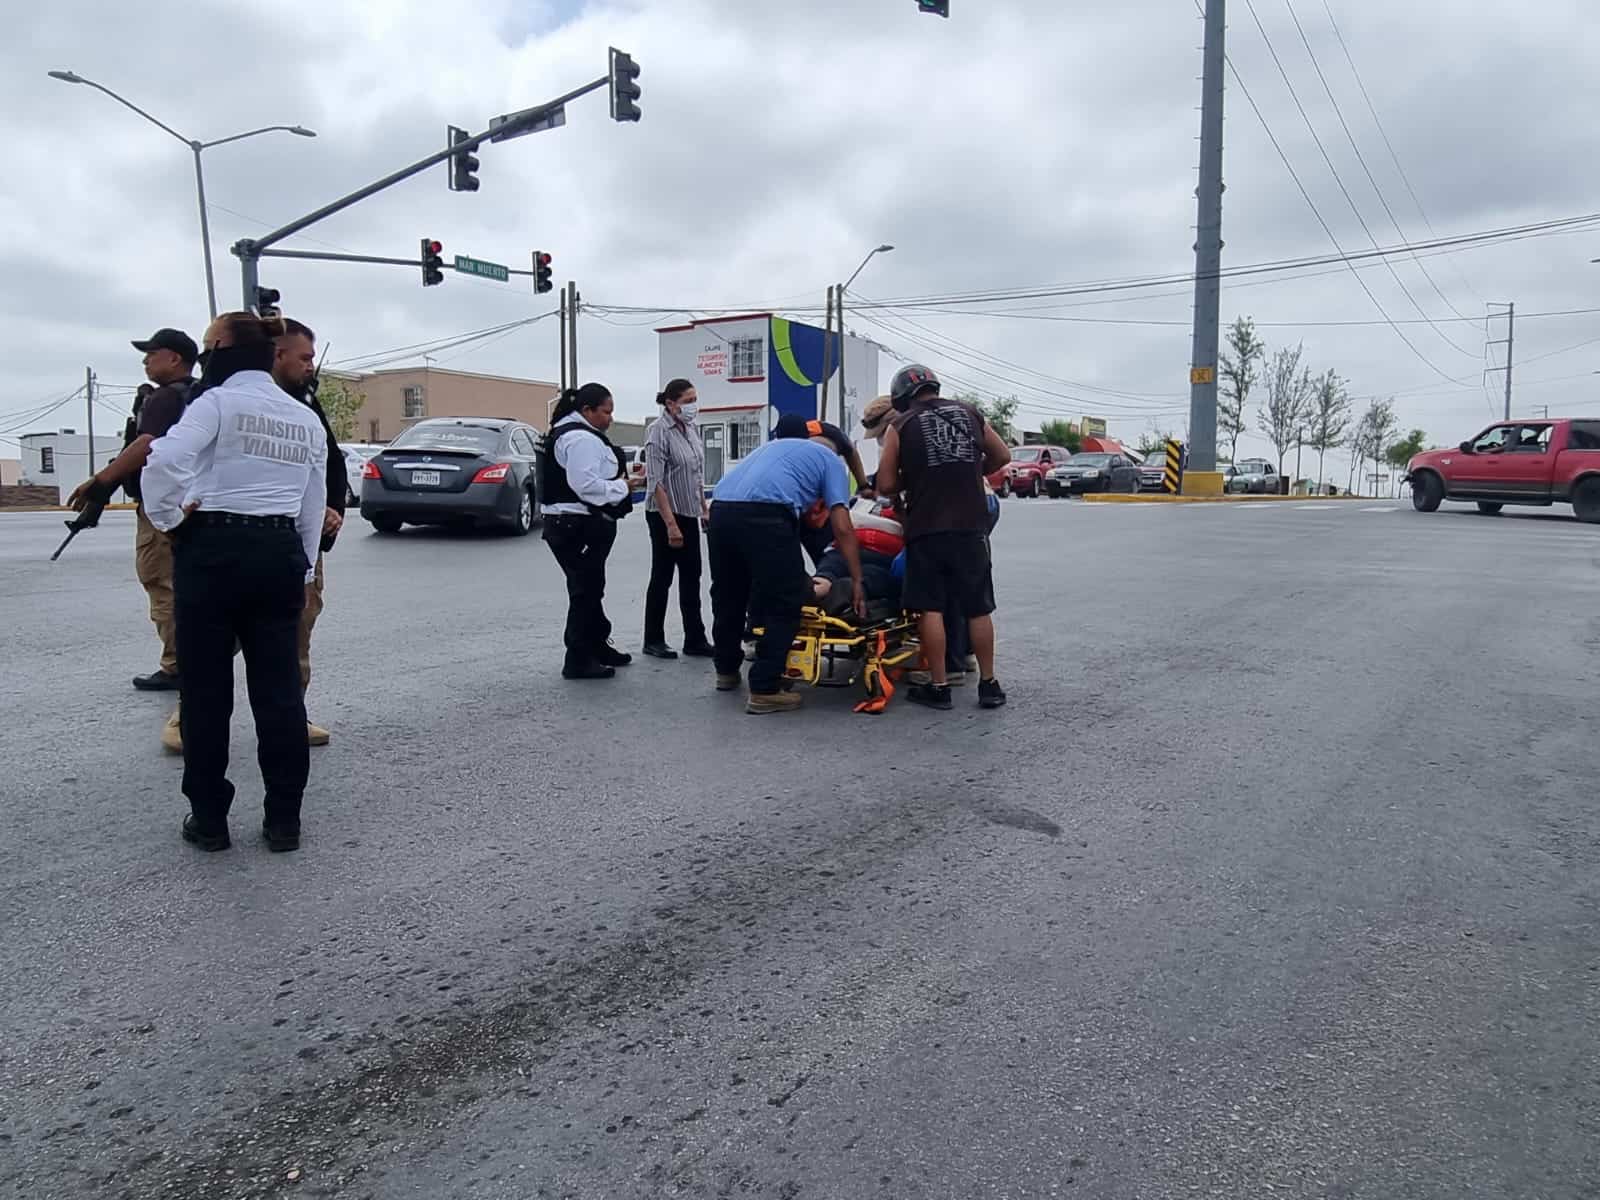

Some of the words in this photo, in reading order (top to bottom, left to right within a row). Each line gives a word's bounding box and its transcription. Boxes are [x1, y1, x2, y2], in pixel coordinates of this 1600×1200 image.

[458, 258, 474, 272] MAR
[478, 262, 506, 279] MUERTO
[241, 434, 311, 465] VIALIDAD
